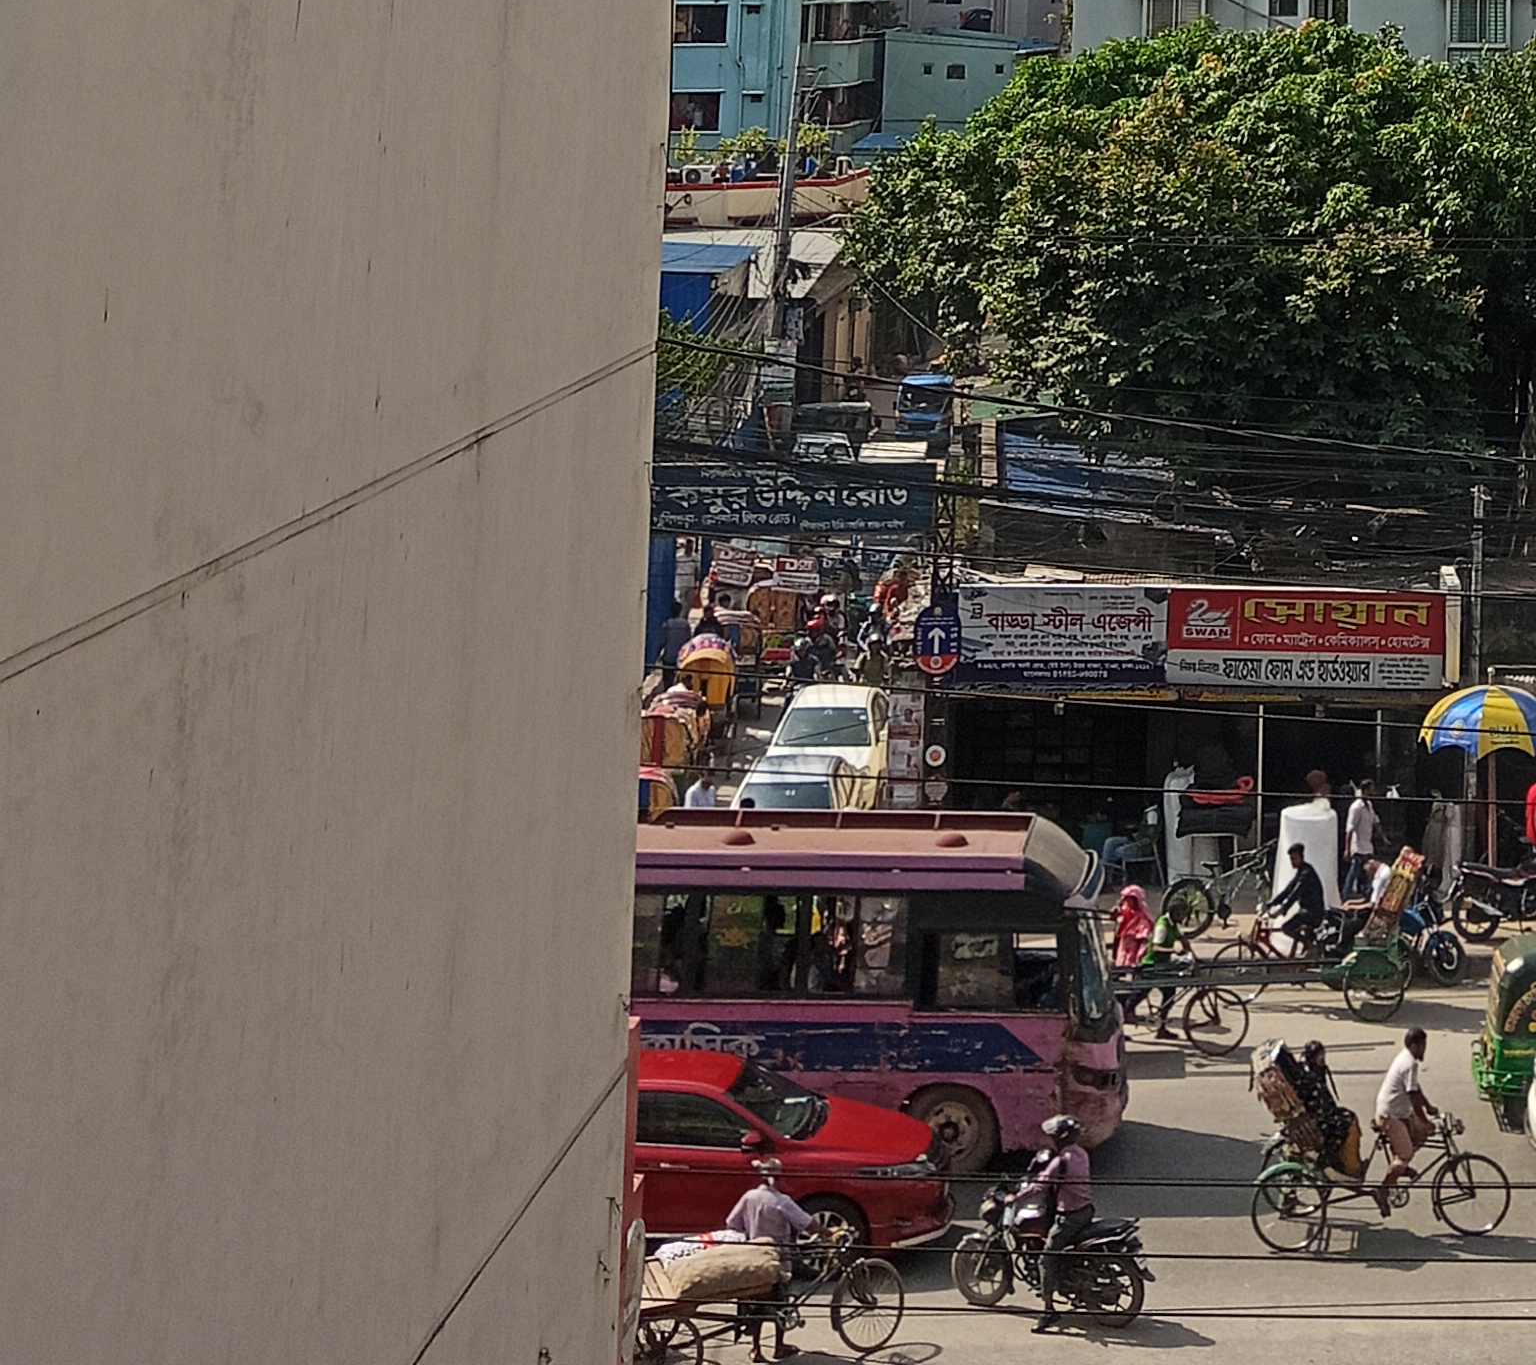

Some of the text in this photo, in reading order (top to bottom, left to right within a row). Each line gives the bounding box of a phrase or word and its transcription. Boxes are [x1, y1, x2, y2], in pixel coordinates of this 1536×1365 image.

[841, 483, 909, 509] রোড
[986, 611, 1038, 632] বাড্ডা
[1042, 605, 1086, 632] স্টীল
[1185, 627, 1230, 638] SWAN
